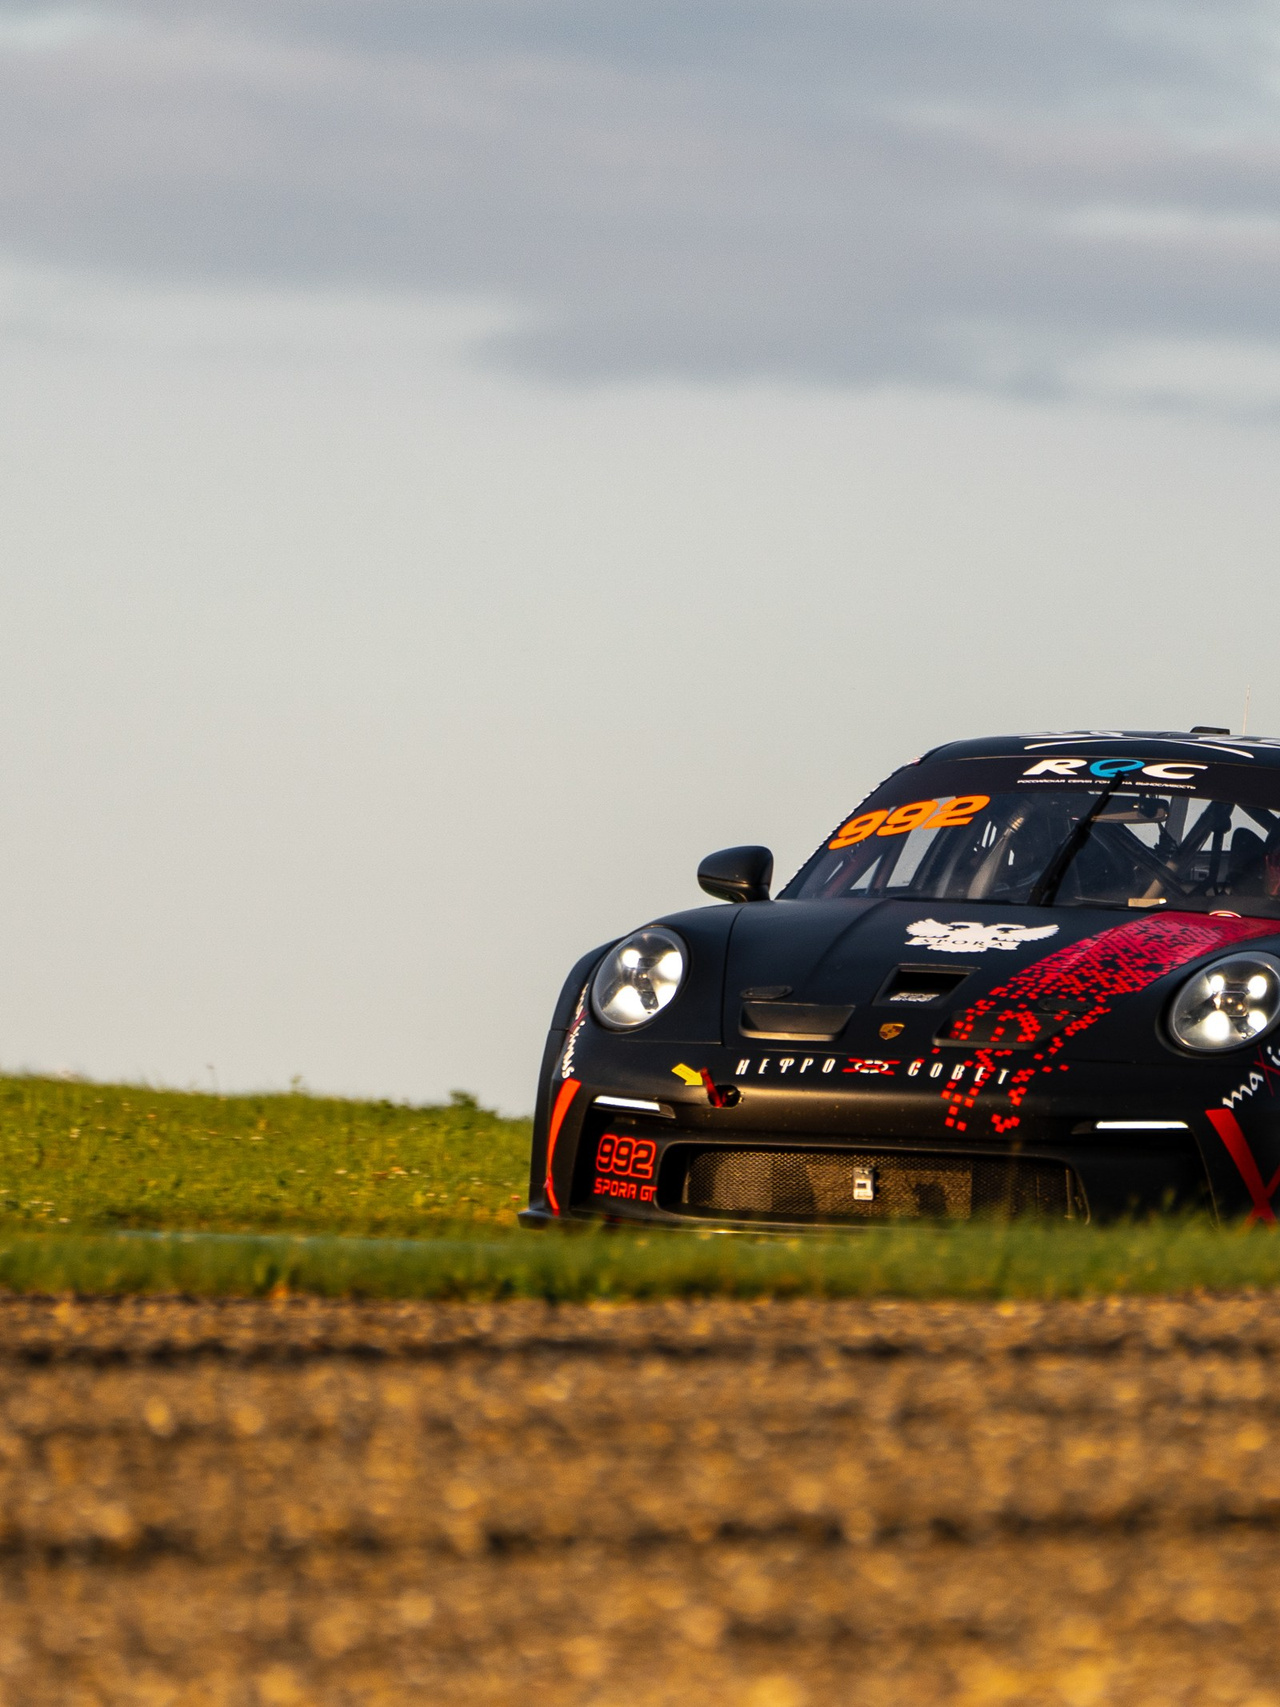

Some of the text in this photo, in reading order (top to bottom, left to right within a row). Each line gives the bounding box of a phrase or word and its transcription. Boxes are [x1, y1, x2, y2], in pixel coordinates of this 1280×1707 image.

[828, 794, 991, 850] 992
[596, 1134, 657, 1179] 992
[593, 1177, 658, 1202] SPORA GT
